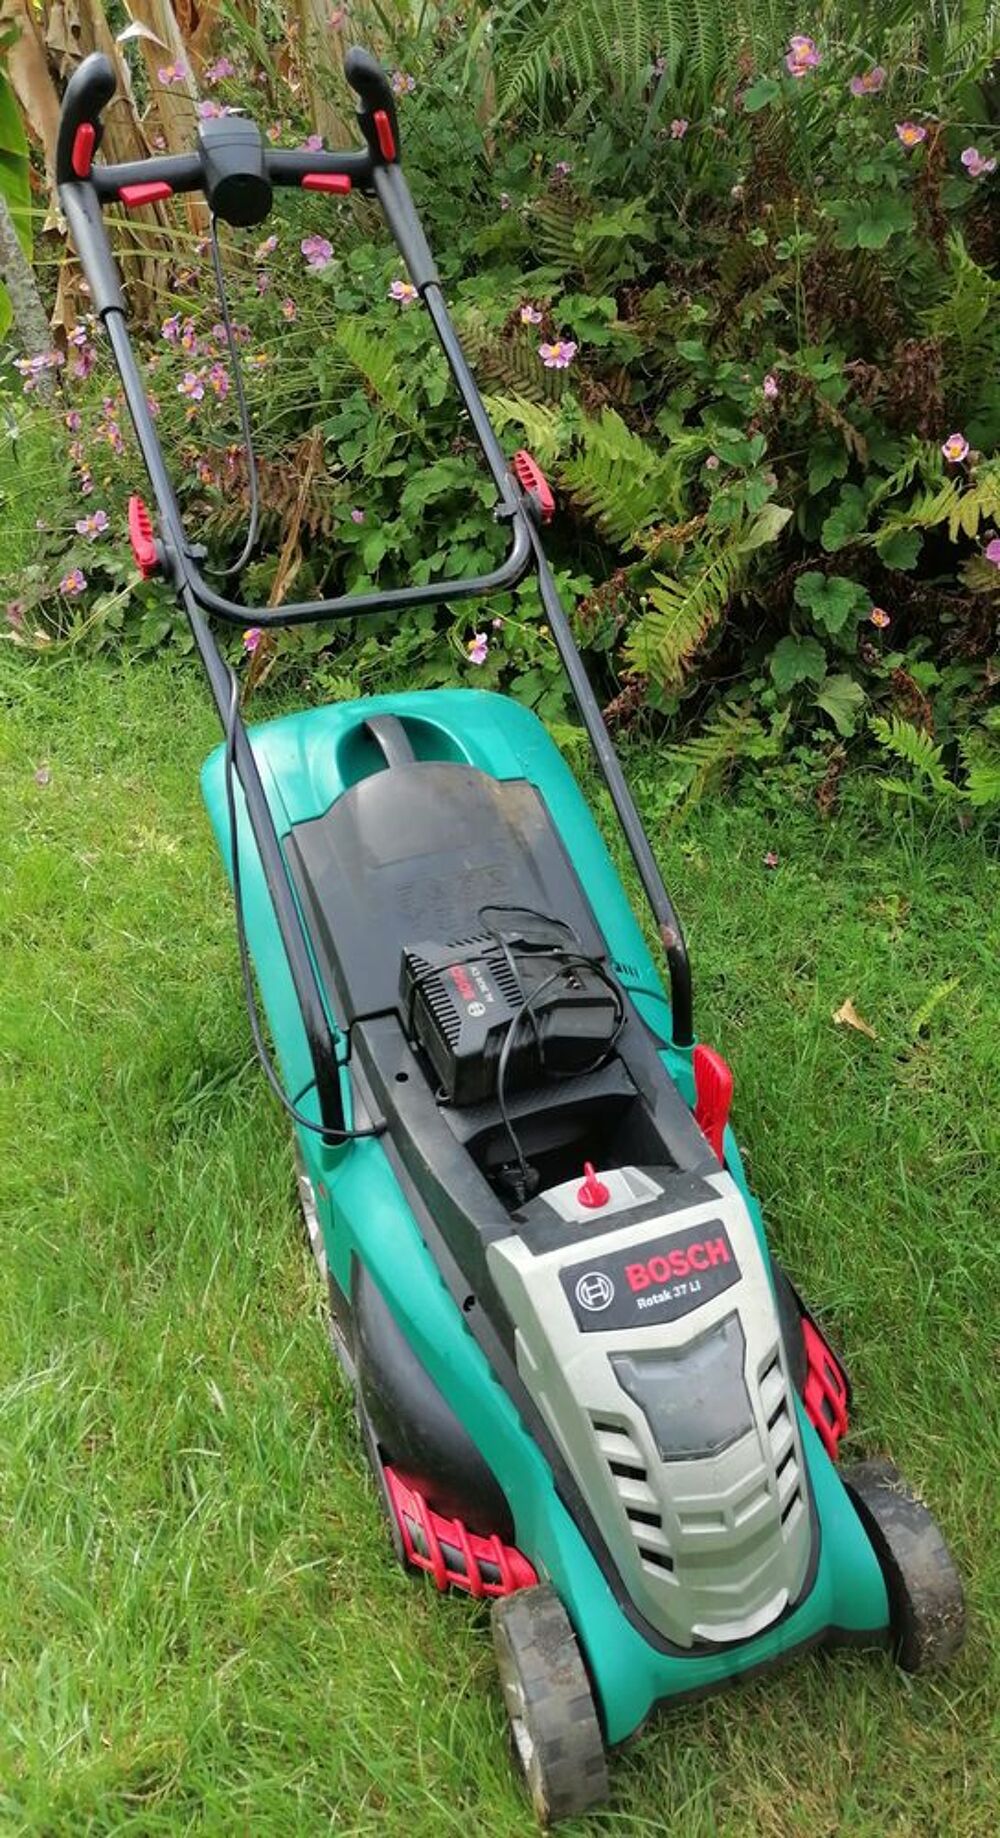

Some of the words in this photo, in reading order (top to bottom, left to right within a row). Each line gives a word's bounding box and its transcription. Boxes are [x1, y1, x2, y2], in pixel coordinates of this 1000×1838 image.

[625, 1236, 731, 1293] BOSCH
[636, 1290, 673, 1309] Rotak
[672, 1284, 687, 1298] 37
